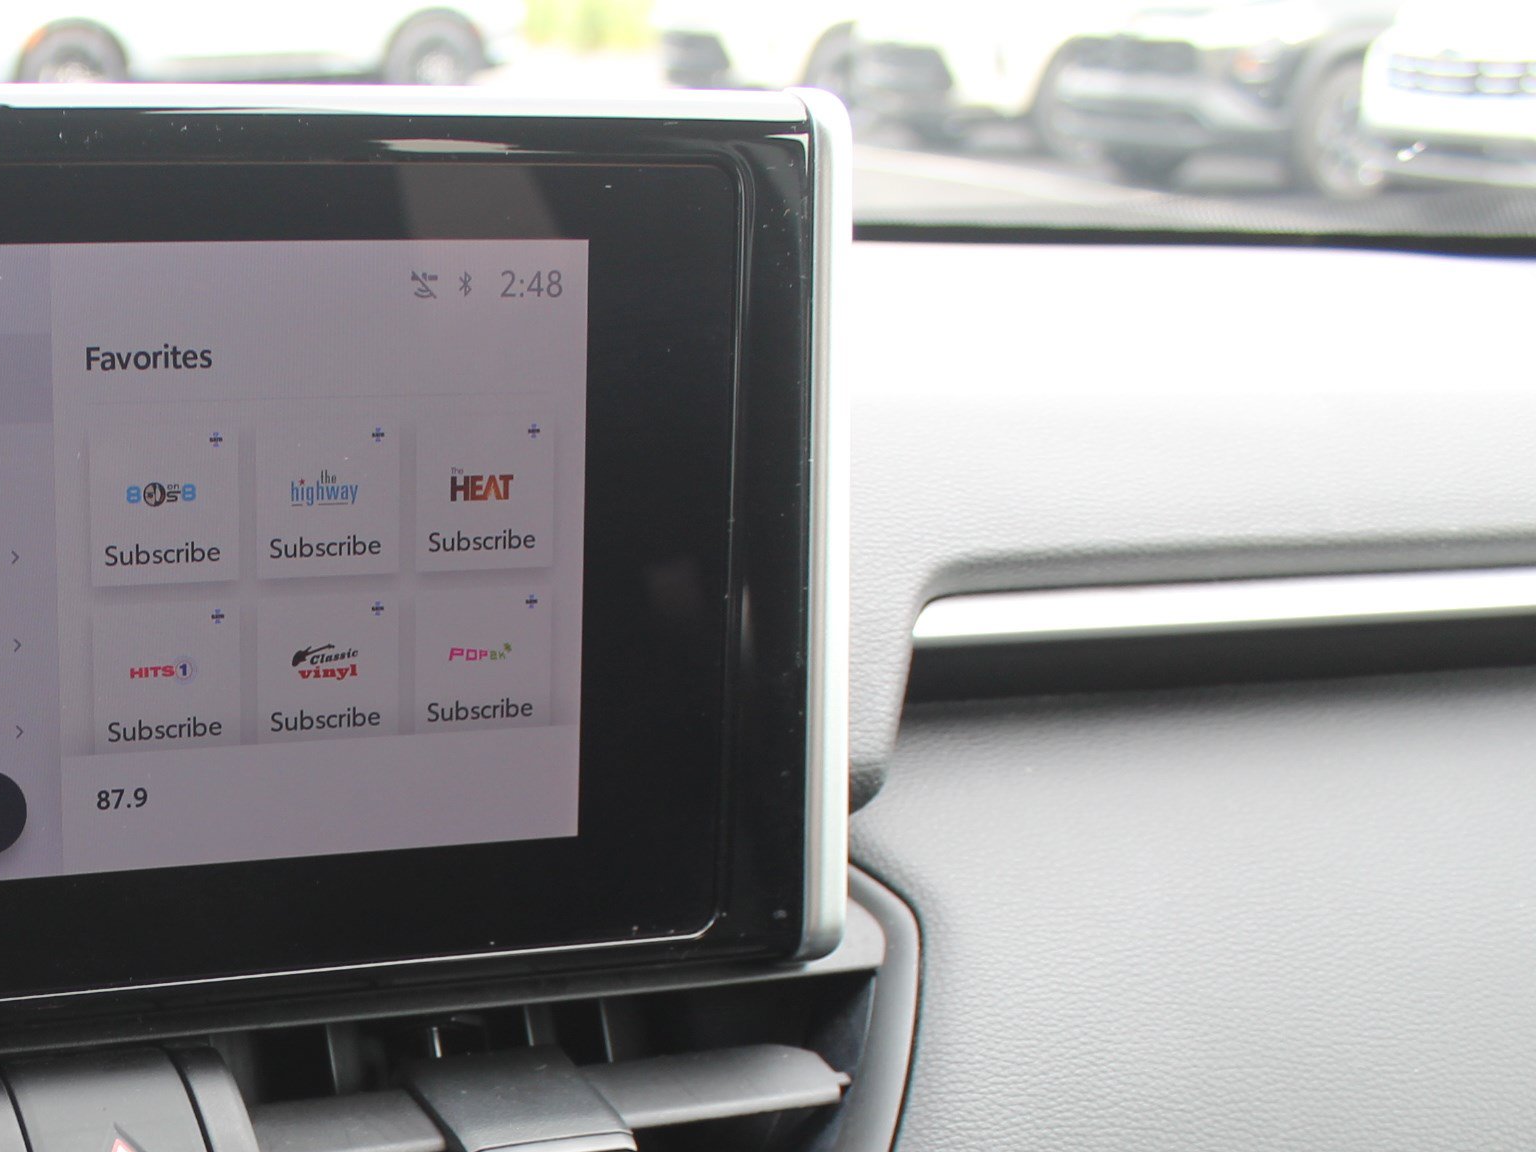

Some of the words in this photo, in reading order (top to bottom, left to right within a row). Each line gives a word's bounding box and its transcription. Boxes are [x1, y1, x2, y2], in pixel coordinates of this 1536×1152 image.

[500, 270, 564, 299] 2:48
[85, 343, 213, 371] Favorites
[320, 469, 337, 485] the
[450, 475, 514, 501] HEAT
[290, 478, 359, 505] highway
[269, 536, 382, 560] Subscribe
[428, 530, 536, 553] Subscribe
[104, 543, 221, 567] Subscribe
[310, 647, 359, 665] Classic
[130, 665, 174, 680] HITS
[298, 664, 358, 681] vinyl
[270, 708, 381, 732] Subscribe
[427, 700, 533, 723] Subscribe
[107, 718, 222, 743] Subscribe
[96, 788, 148, 811] 87.9
